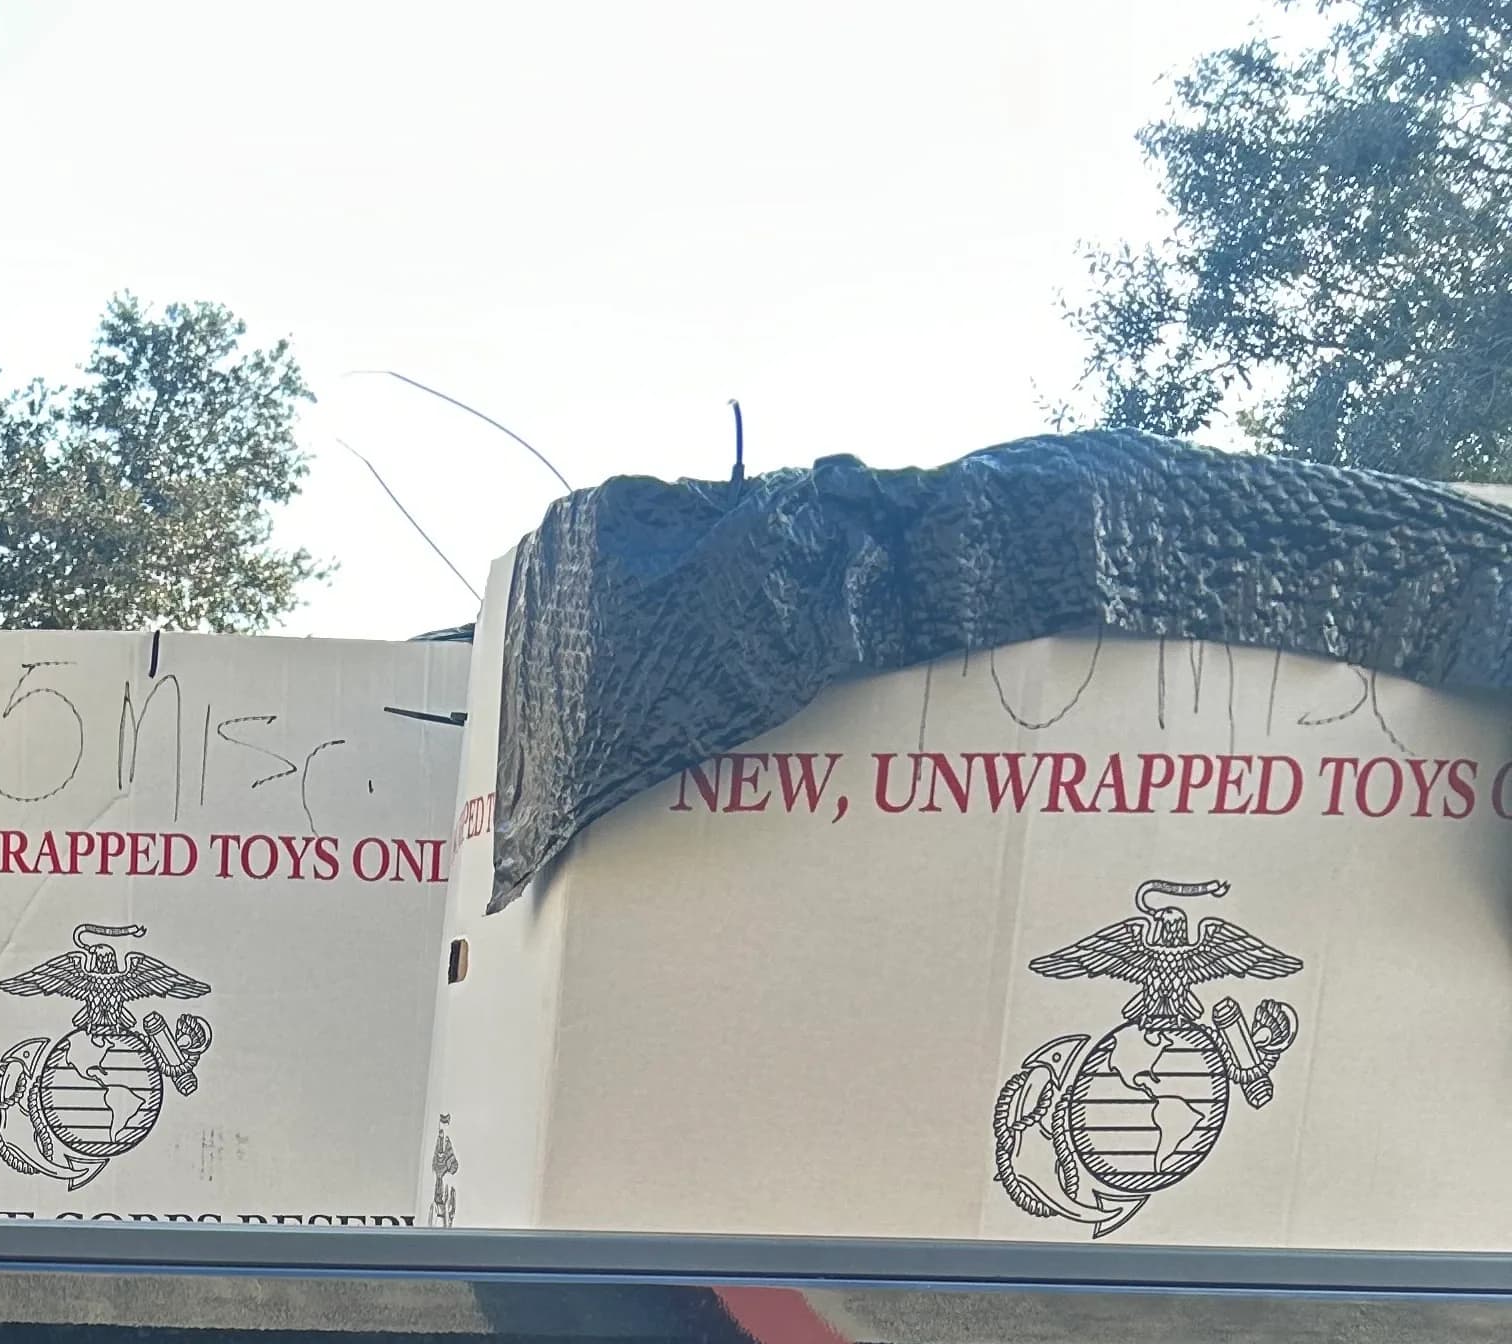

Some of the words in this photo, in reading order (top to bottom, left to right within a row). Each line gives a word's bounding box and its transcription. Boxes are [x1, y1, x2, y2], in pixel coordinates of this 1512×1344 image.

[669, 752, 849, 824] NEW,
[871, 751, 1304, 815] UNWRAPPED
[1318, 756, 1479, 820] TOYS
[210, 833, 341, 883] TOYS
[352, 836, 449, 883] ONL
